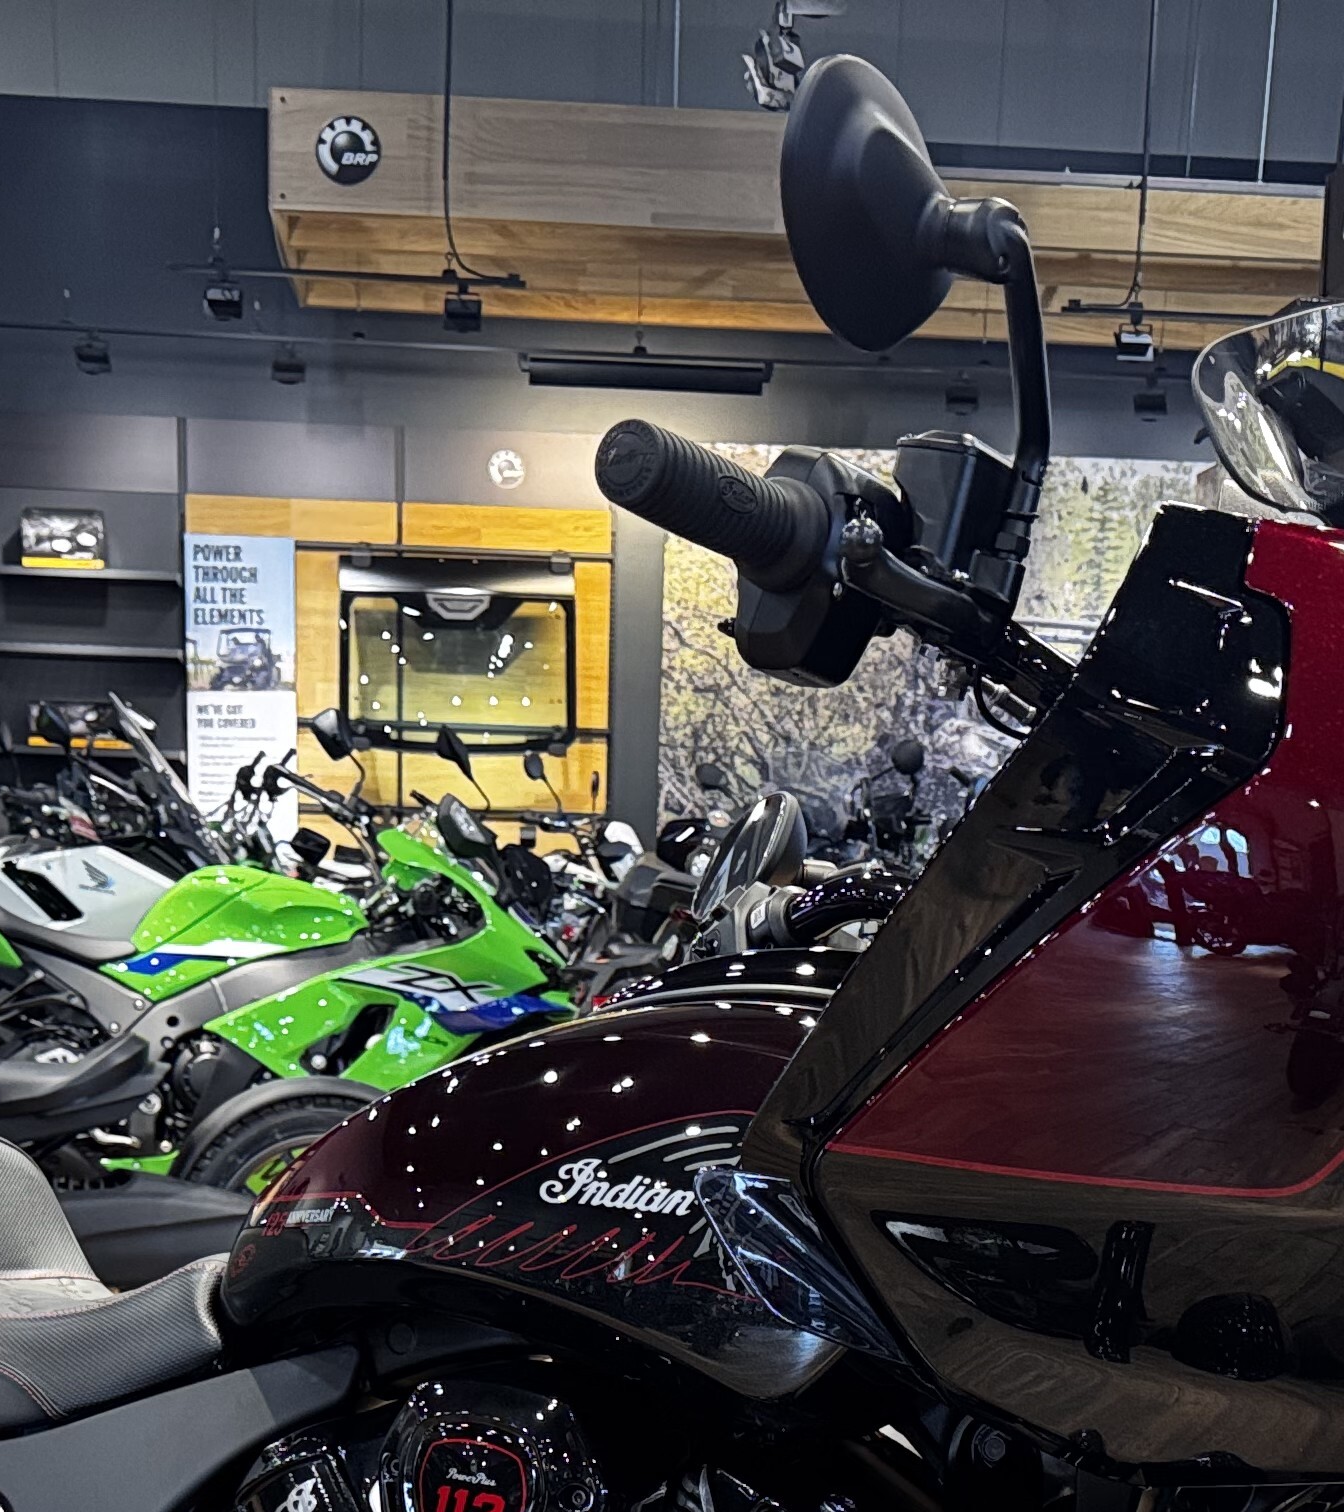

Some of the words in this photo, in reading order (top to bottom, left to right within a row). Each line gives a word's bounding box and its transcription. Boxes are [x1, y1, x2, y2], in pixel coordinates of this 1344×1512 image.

[341, 152, 378, 165] BRP
[192, 544, 243, 562] POWER
[192, 565, 258, 584] THROUGH
[193, 586, 217, 604] ALL
[220, 586, 248, 605] THE
[193, 607, 265, 626] ELEMENTS
[539, 1158, 696, 1216] Indian
[285, 1207, 336, 1225] ANNIVERSARY
